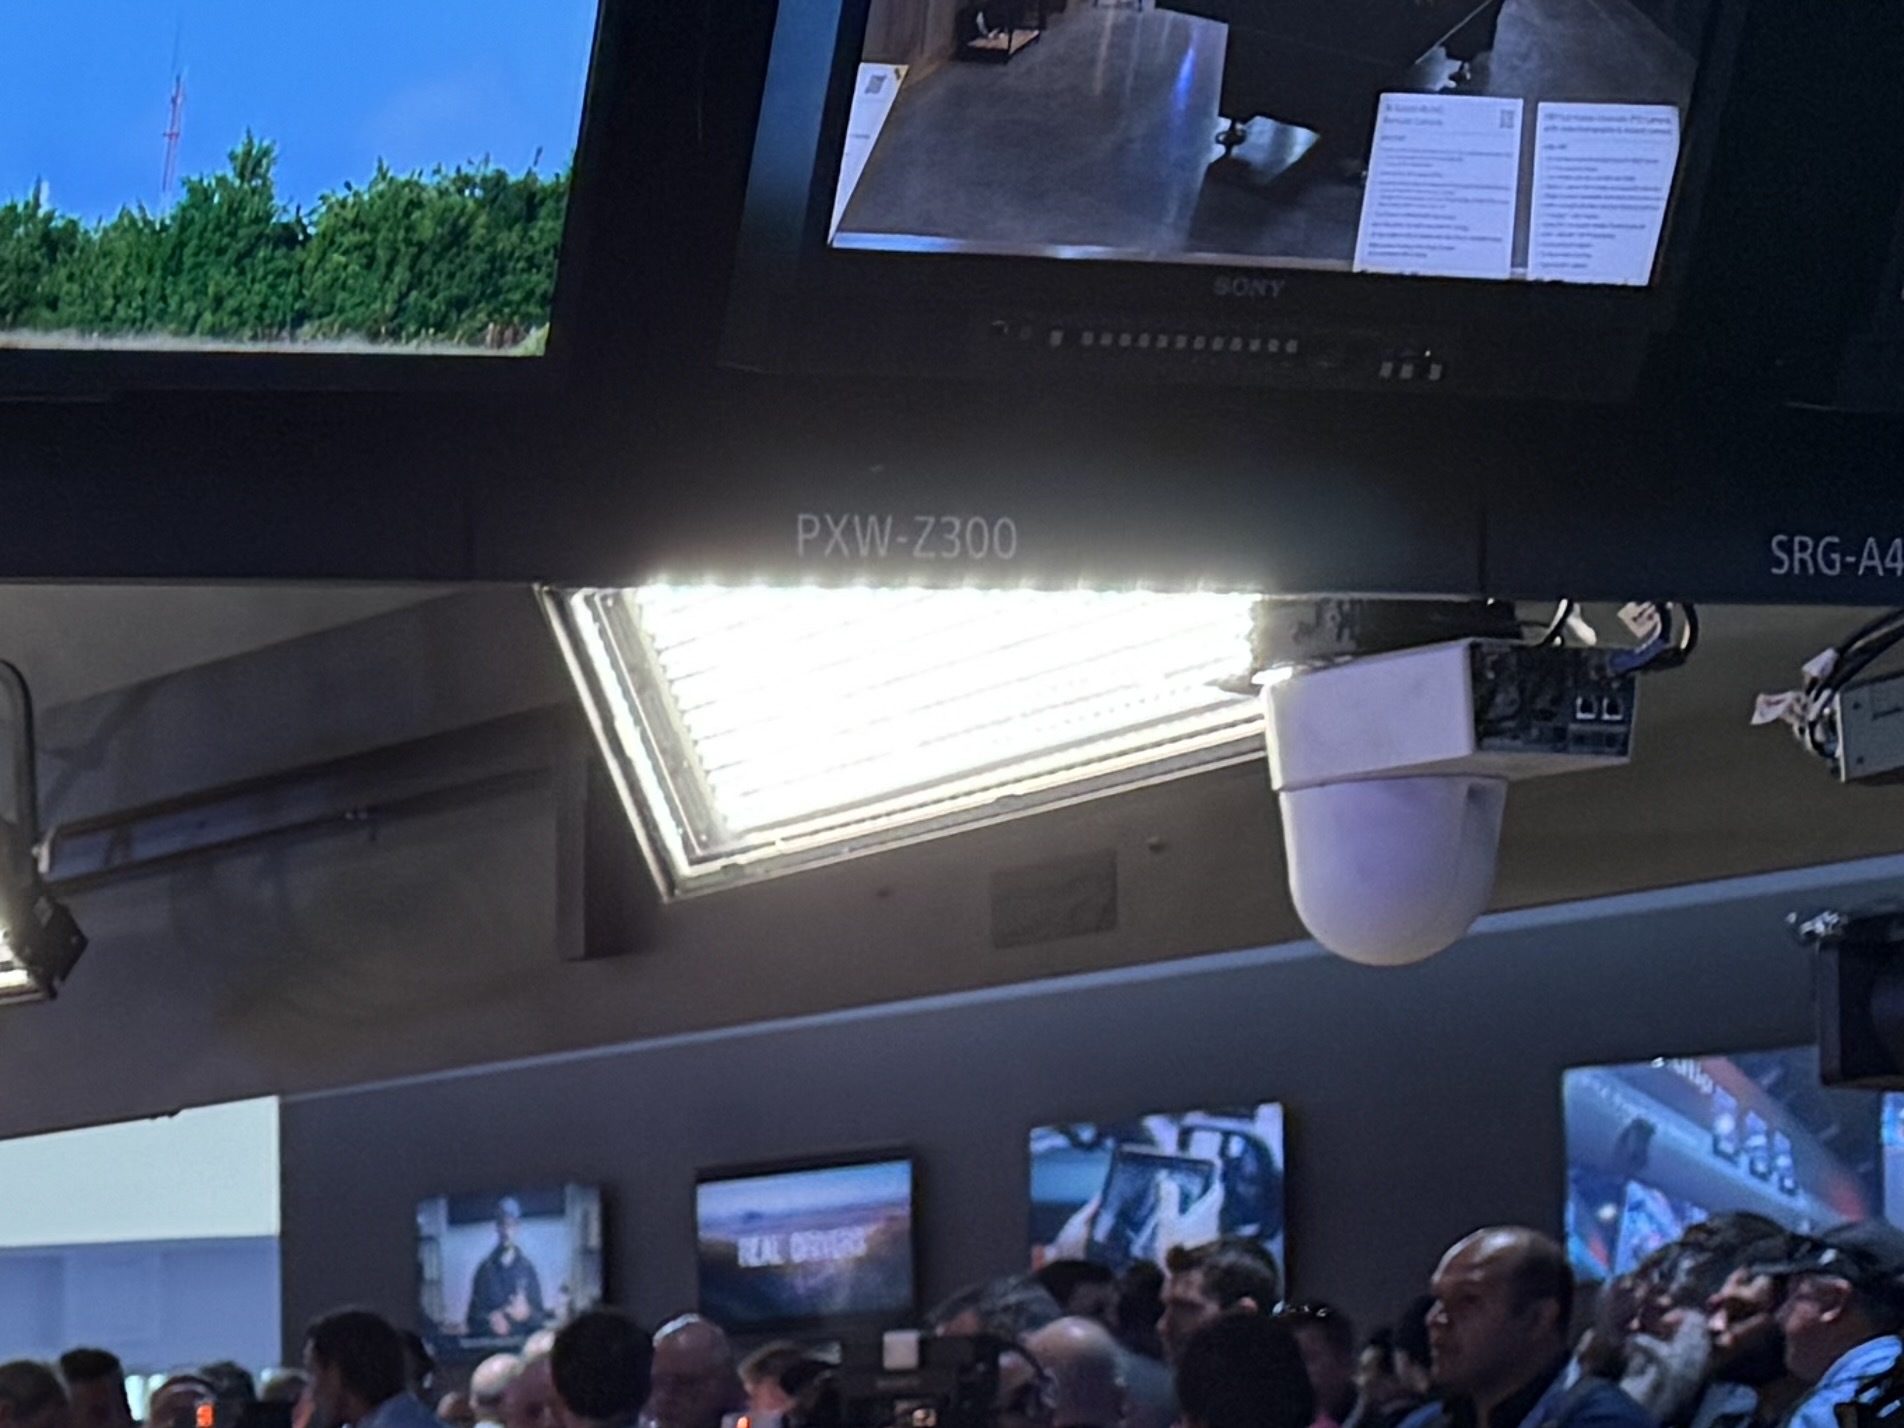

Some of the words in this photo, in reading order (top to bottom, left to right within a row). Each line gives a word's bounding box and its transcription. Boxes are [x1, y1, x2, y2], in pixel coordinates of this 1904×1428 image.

[1213, 275, 1285, 298] SONY
[795, 512, 1018, 561] PXW-Z300
[1770, 533, 1904, 577] SRG-A4
